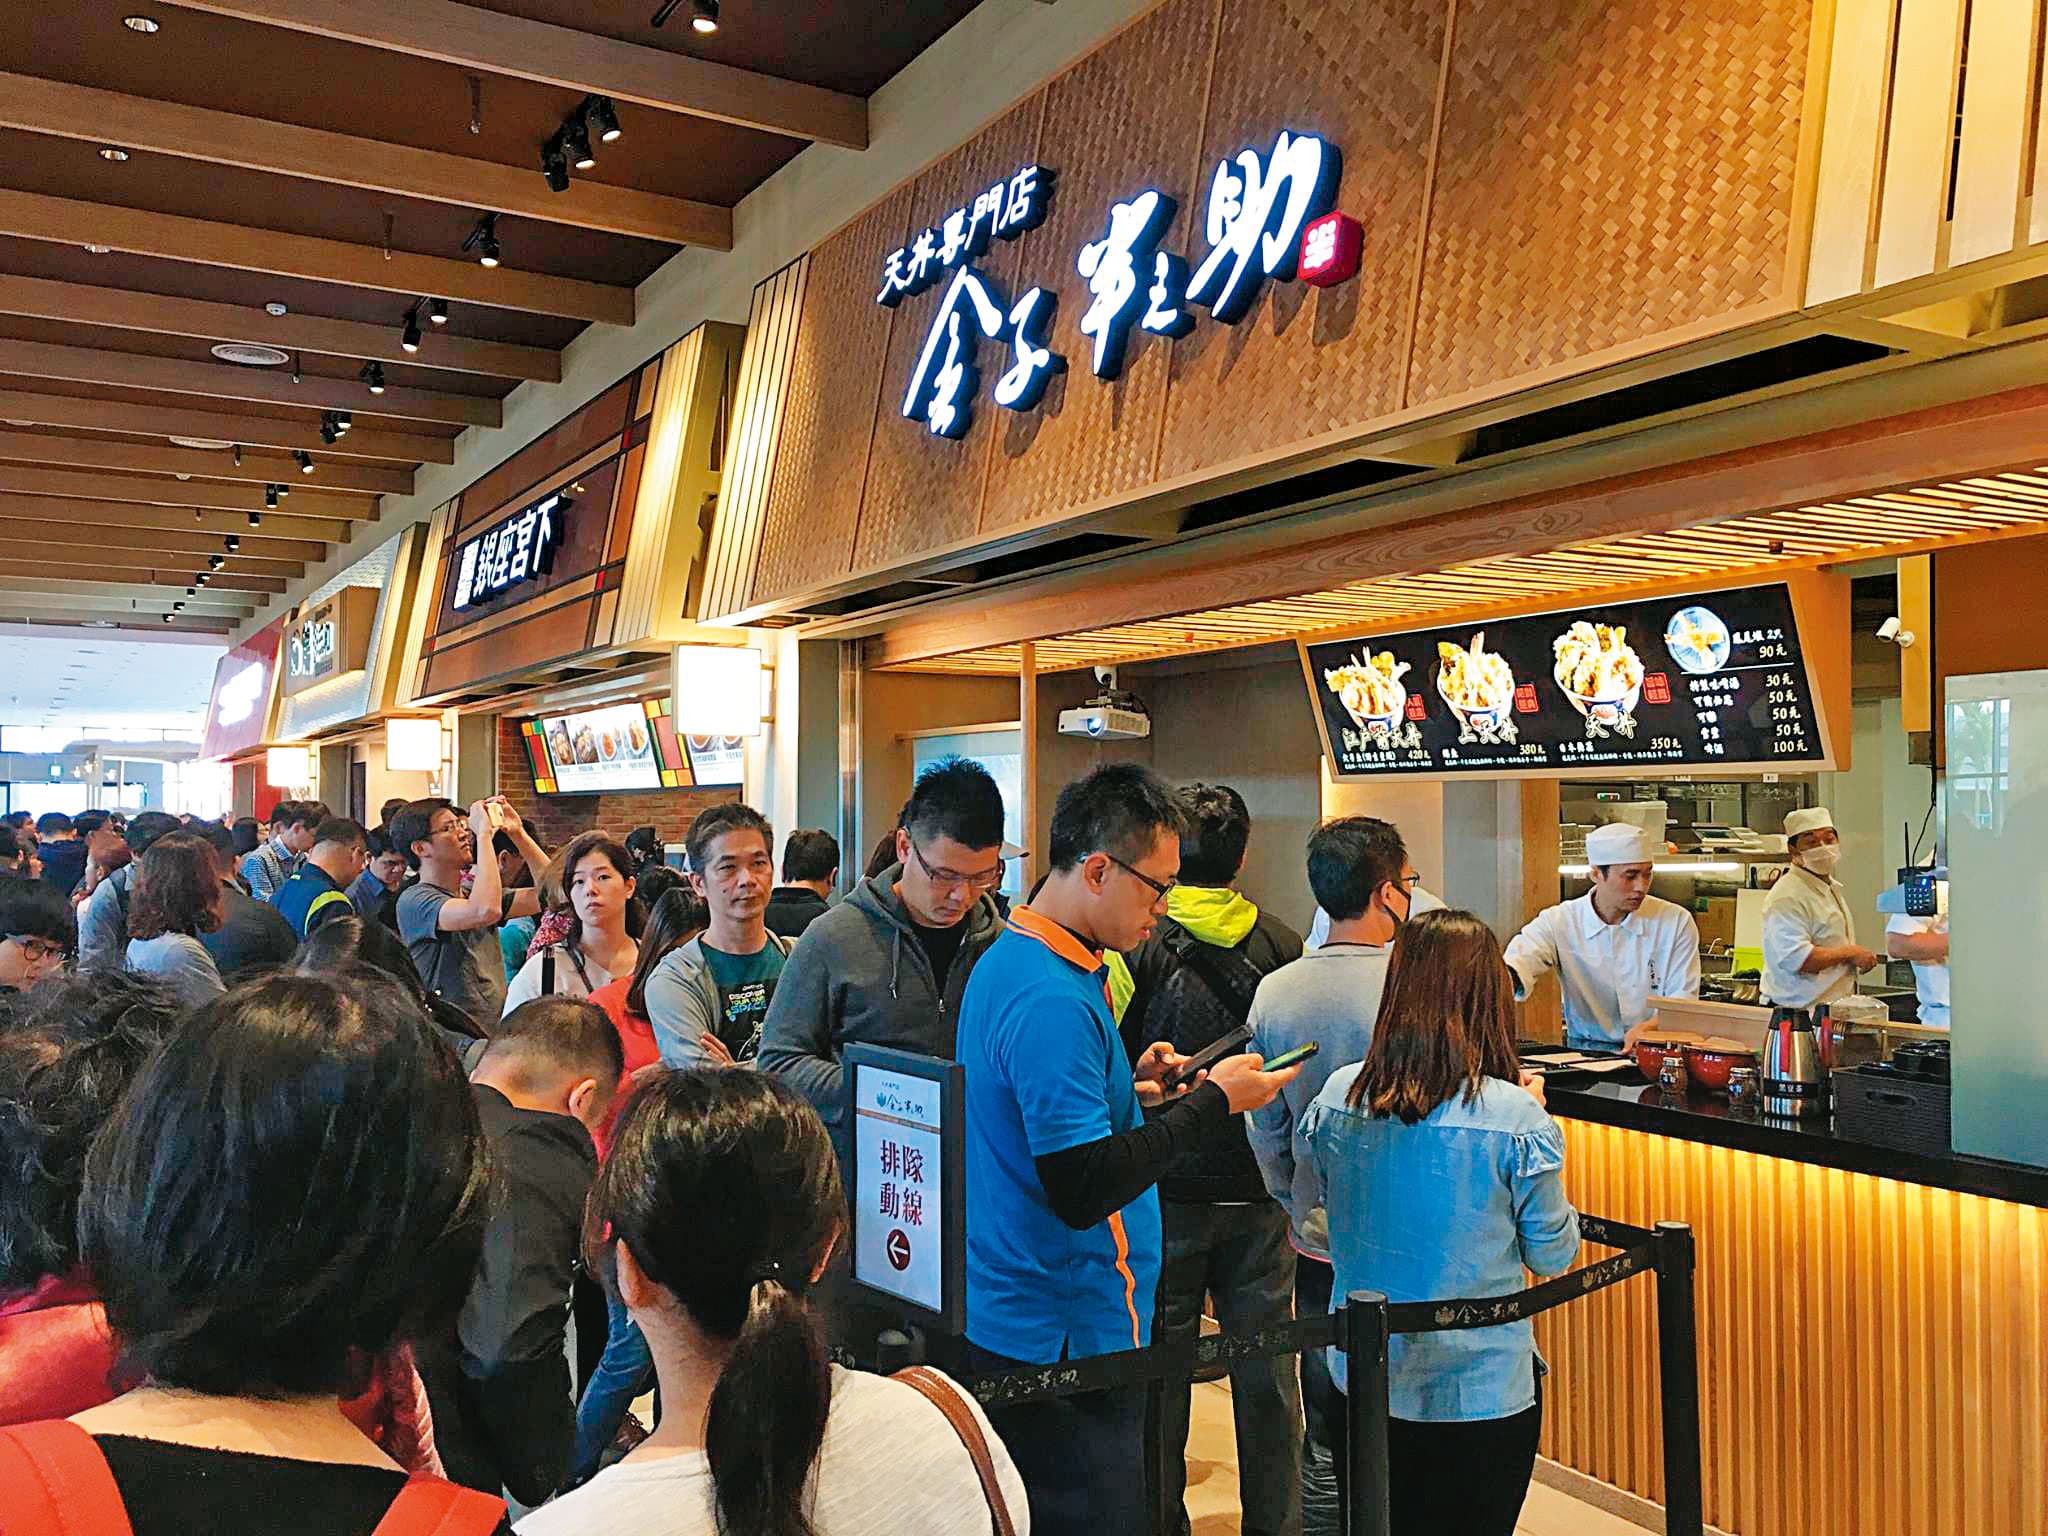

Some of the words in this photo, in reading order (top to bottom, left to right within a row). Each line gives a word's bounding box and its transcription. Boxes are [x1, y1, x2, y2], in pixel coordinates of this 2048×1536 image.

[877, 165, 1038, 303] 天丼專門店
[472, 495, 559, 598] 銀座宮下
[1759, 643, 1787, 658] 90元
[1765, 672, 1794, 687] 30元
[1768, 689, 1798, 703] 50元
[1772, 705, 1801, 720] 50元
[1585, 710, 1638, 740] 天丼
[1776, 722, 1805, 736] 50元
[1519, 743, 1546, 755] 380元
[1650, 737, 1682, 749] 350元
[1773, 738, 1808, 753] 100元
[880, 1139, 924, 1184] 排隊
[880, 1181, 922, 1226] 動線
